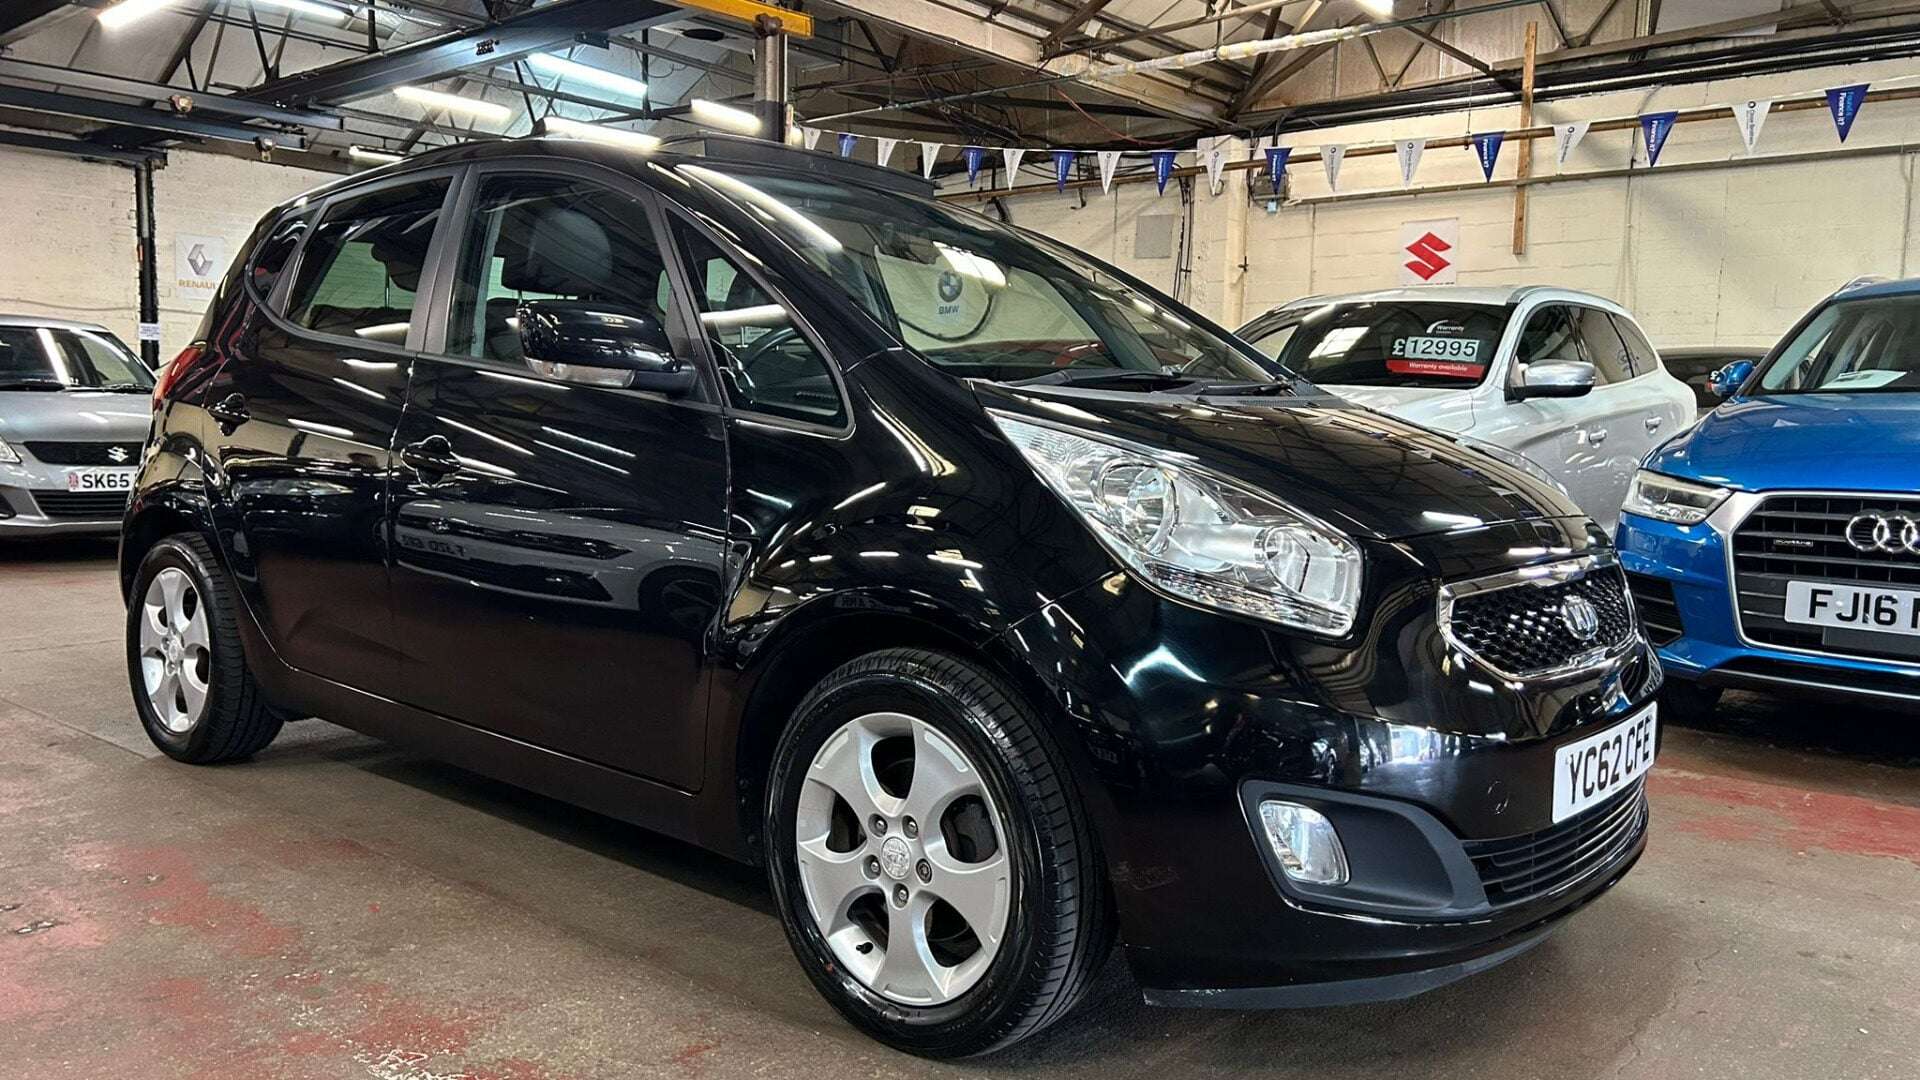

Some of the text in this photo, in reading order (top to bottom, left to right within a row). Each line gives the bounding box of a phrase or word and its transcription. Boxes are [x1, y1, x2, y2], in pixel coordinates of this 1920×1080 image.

[178, 279, 217, 289] RENAUL
[938, 304, 960, 315] BMW
[1392, 338, 1476, 357] £12995
[1409, 361, 1437, 371] Warranty
[82, 473, 129, 488] SK65
[1809, 589, 1898, 626] FJ16
[1570, 715, 1651, 805] YC62 CFE
